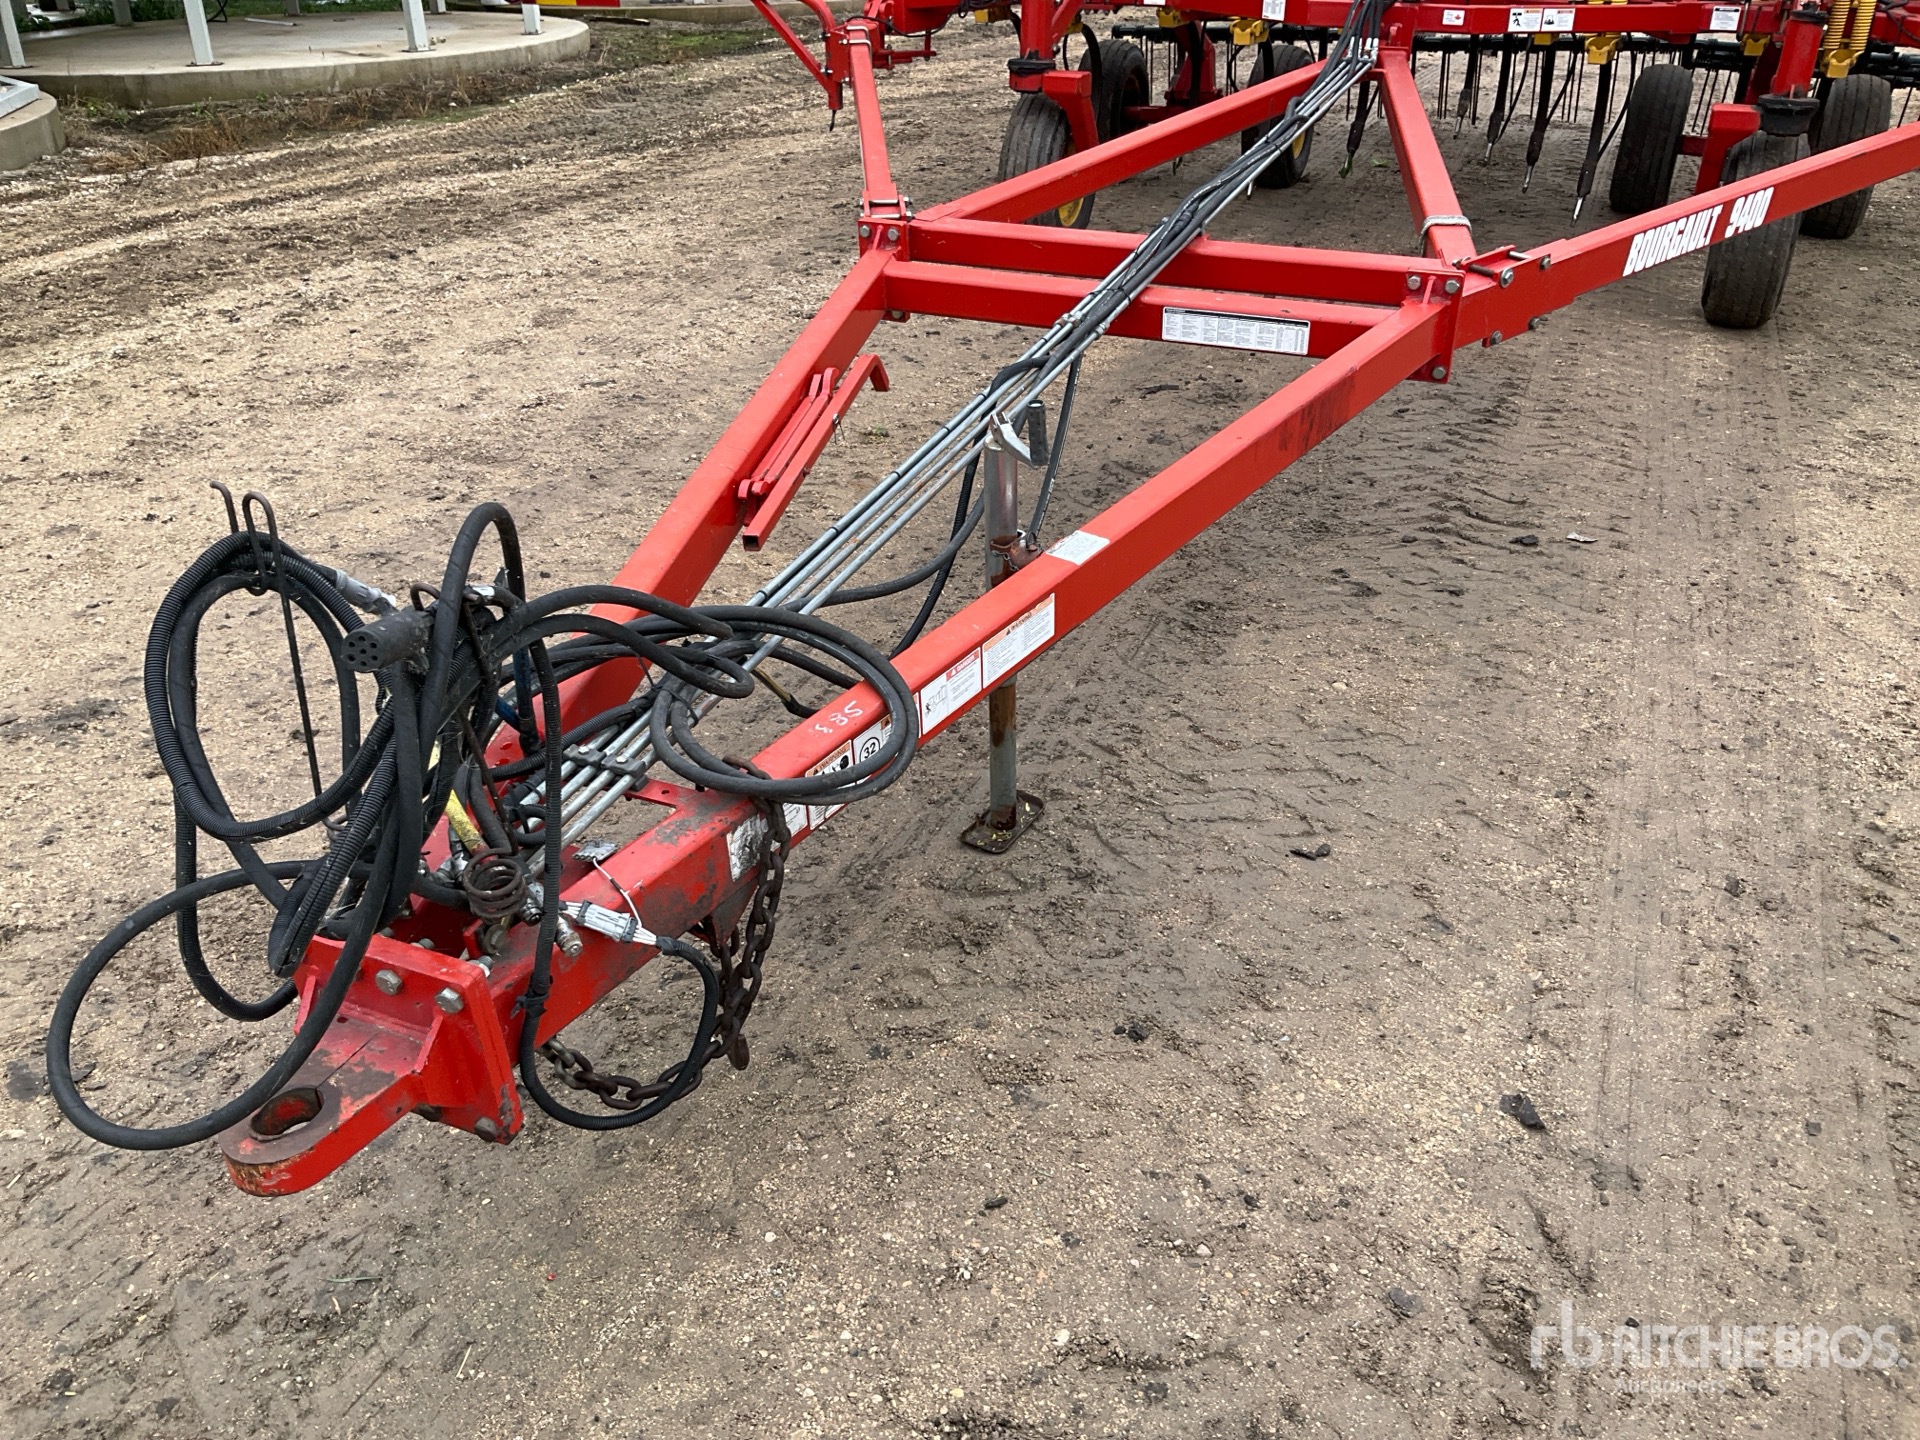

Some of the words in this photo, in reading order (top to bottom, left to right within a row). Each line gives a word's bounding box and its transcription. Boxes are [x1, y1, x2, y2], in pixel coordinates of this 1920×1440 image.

[1622, 204, 1724, 277] BOURGAULT
[1724, 186, 1775, 239] 9400
[863, 741, 876, 759] 32
